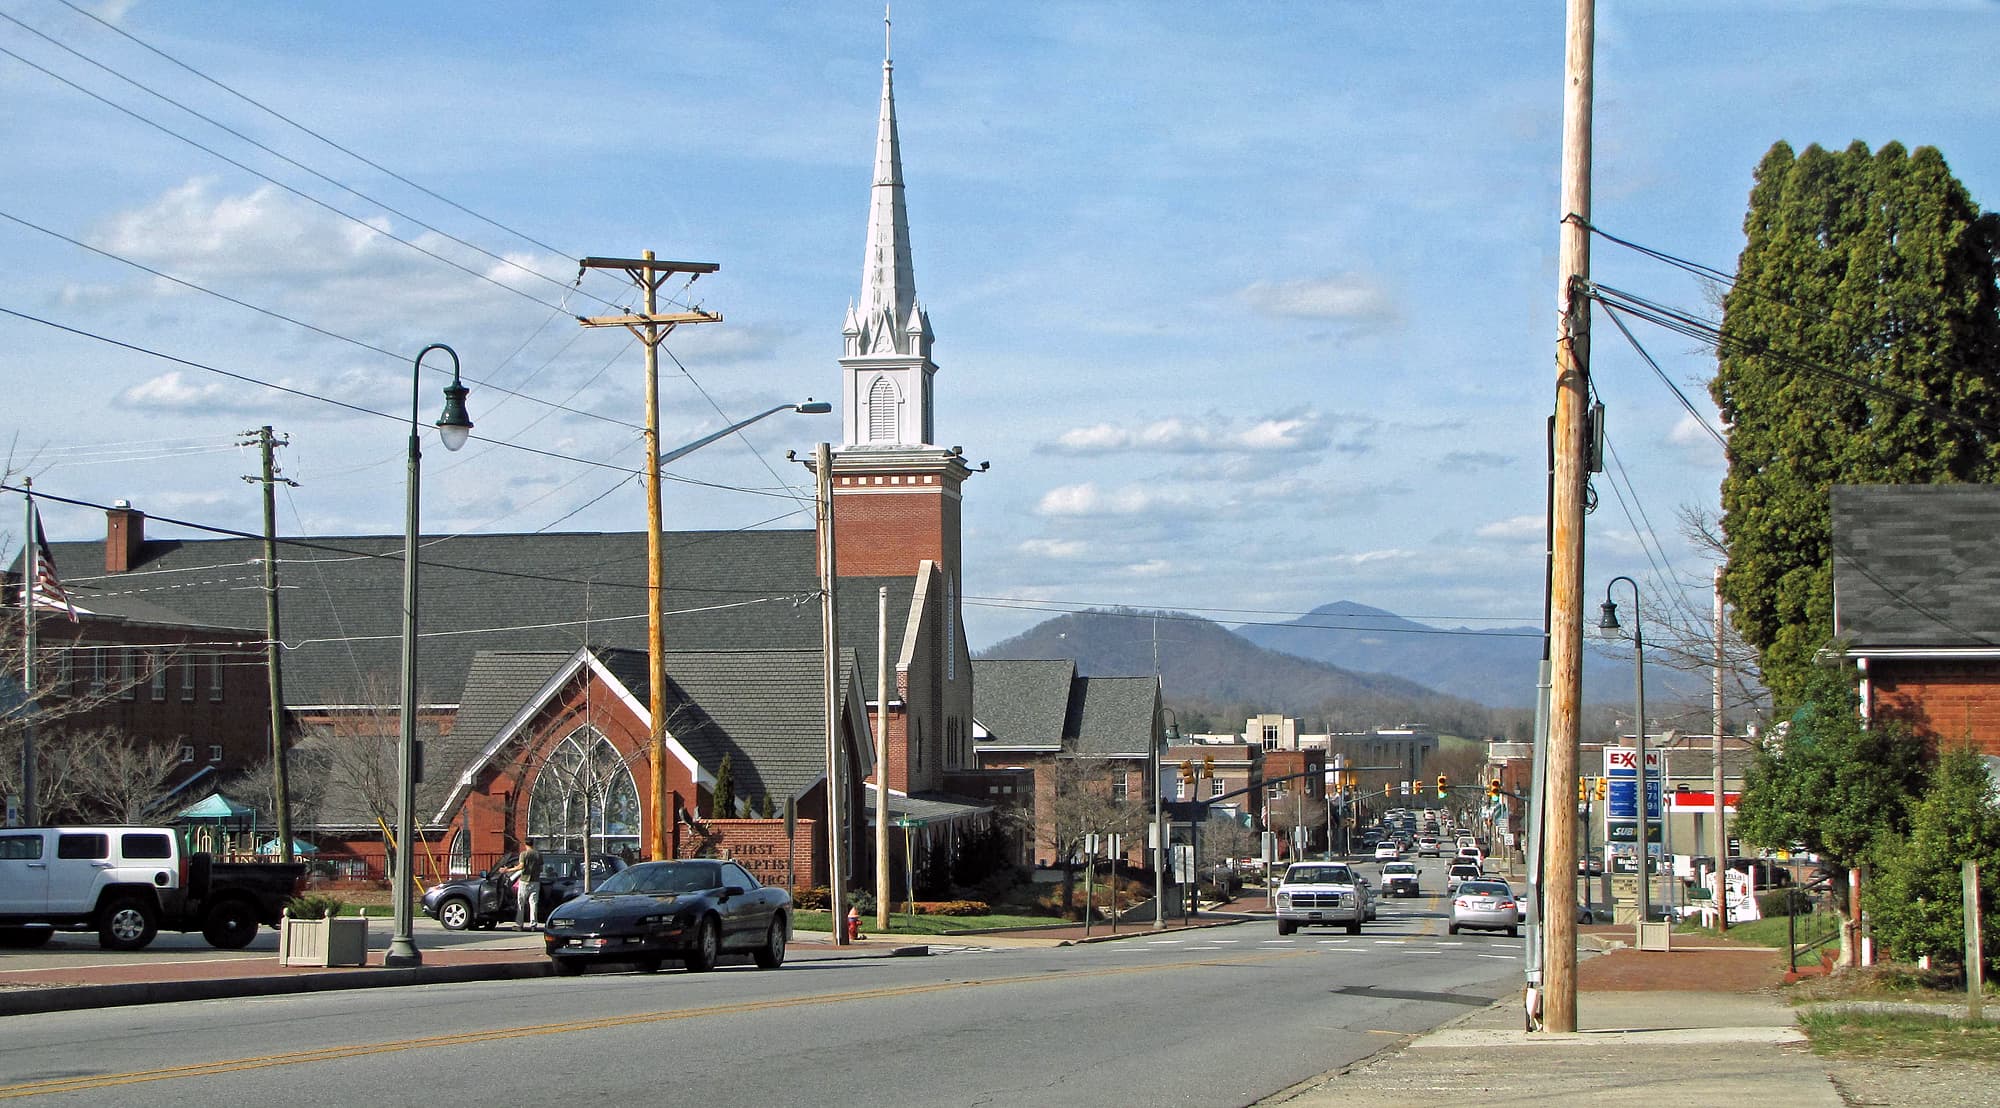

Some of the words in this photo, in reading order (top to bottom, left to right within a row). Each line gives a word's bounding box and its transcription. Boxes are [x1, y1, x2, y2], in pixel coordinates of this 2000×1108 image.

[1610, 752, 1657, 768] EXXN
[1613, 827, 1658, 836] SUBY
[734, 844, 775, 854] FIRST
